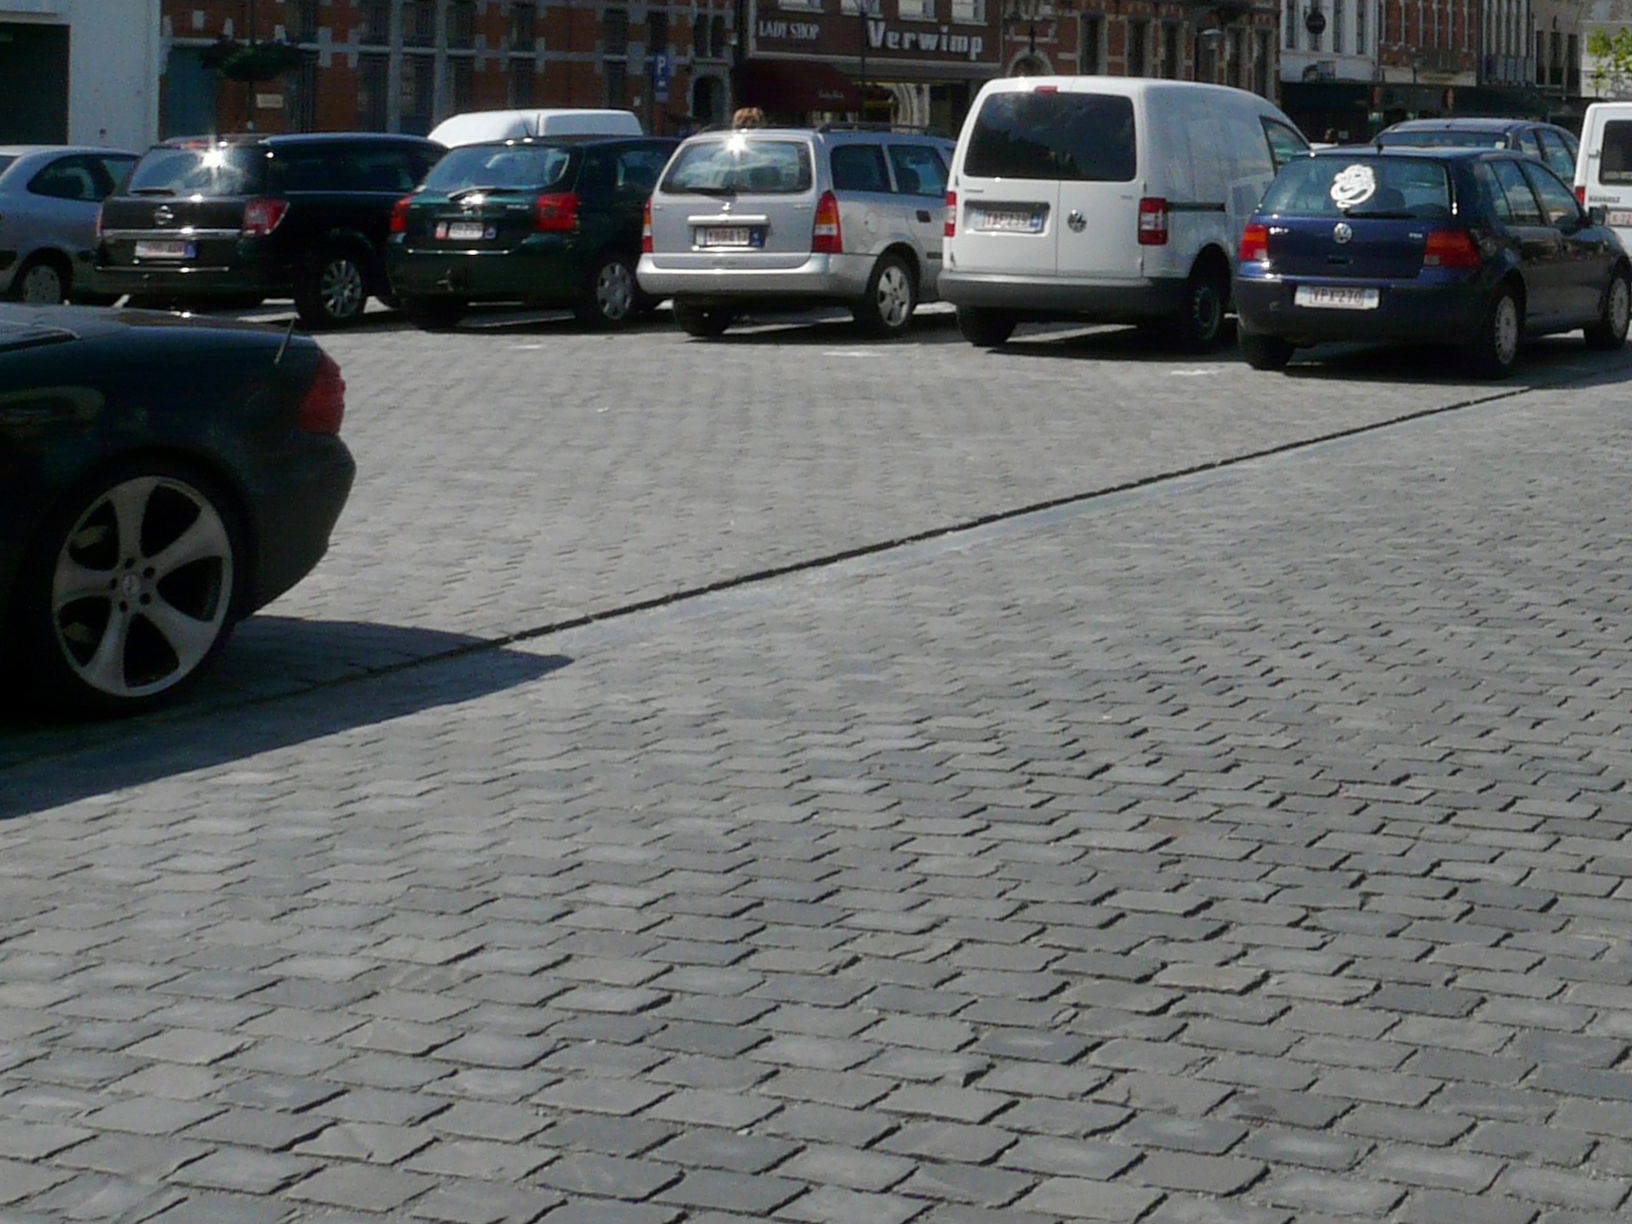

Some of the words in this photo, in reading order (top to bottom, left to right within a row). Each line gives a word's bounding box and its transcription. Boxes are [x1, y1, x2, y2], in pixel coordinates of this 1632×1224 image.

[759, 20, 788, 38] LADY
[790, 22, 820, 40] SHOP
[866, 20, 983, 60] Verwimp
